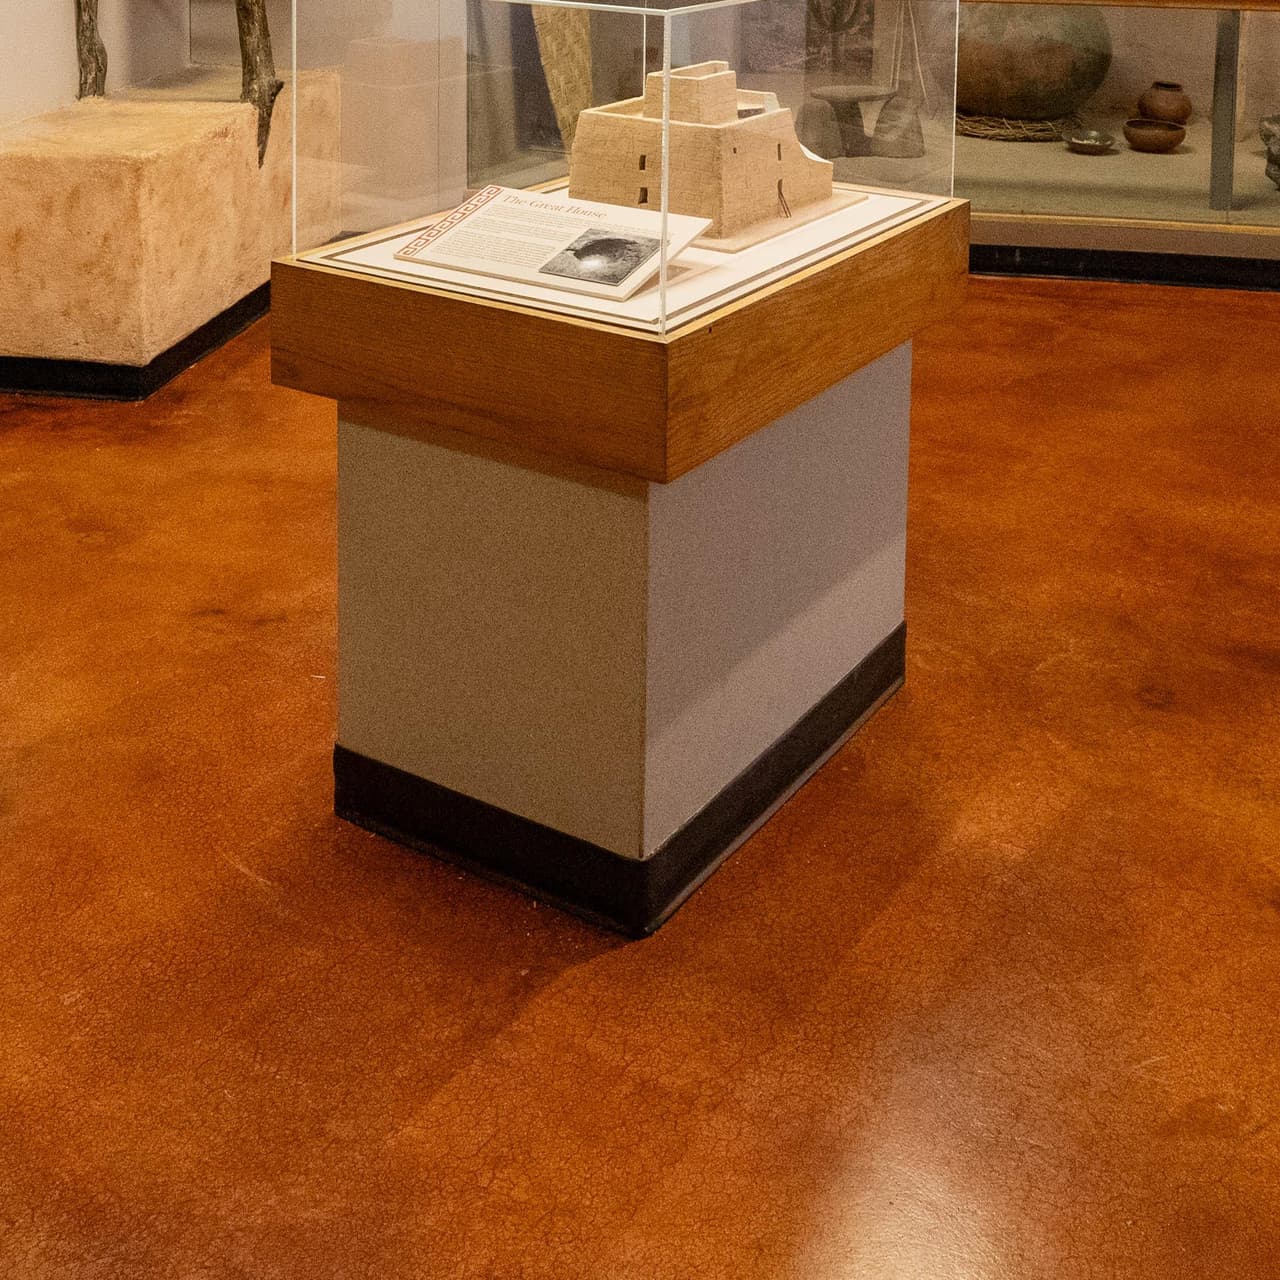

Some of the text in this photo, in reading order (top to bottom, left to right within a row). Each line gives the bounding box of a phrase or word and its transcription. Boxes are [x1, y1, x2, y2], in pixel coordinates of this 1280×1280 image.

[503, 194, 527, 205] The
[529, 200, 564, 212] Great
[566, 205, 608, 218] House
